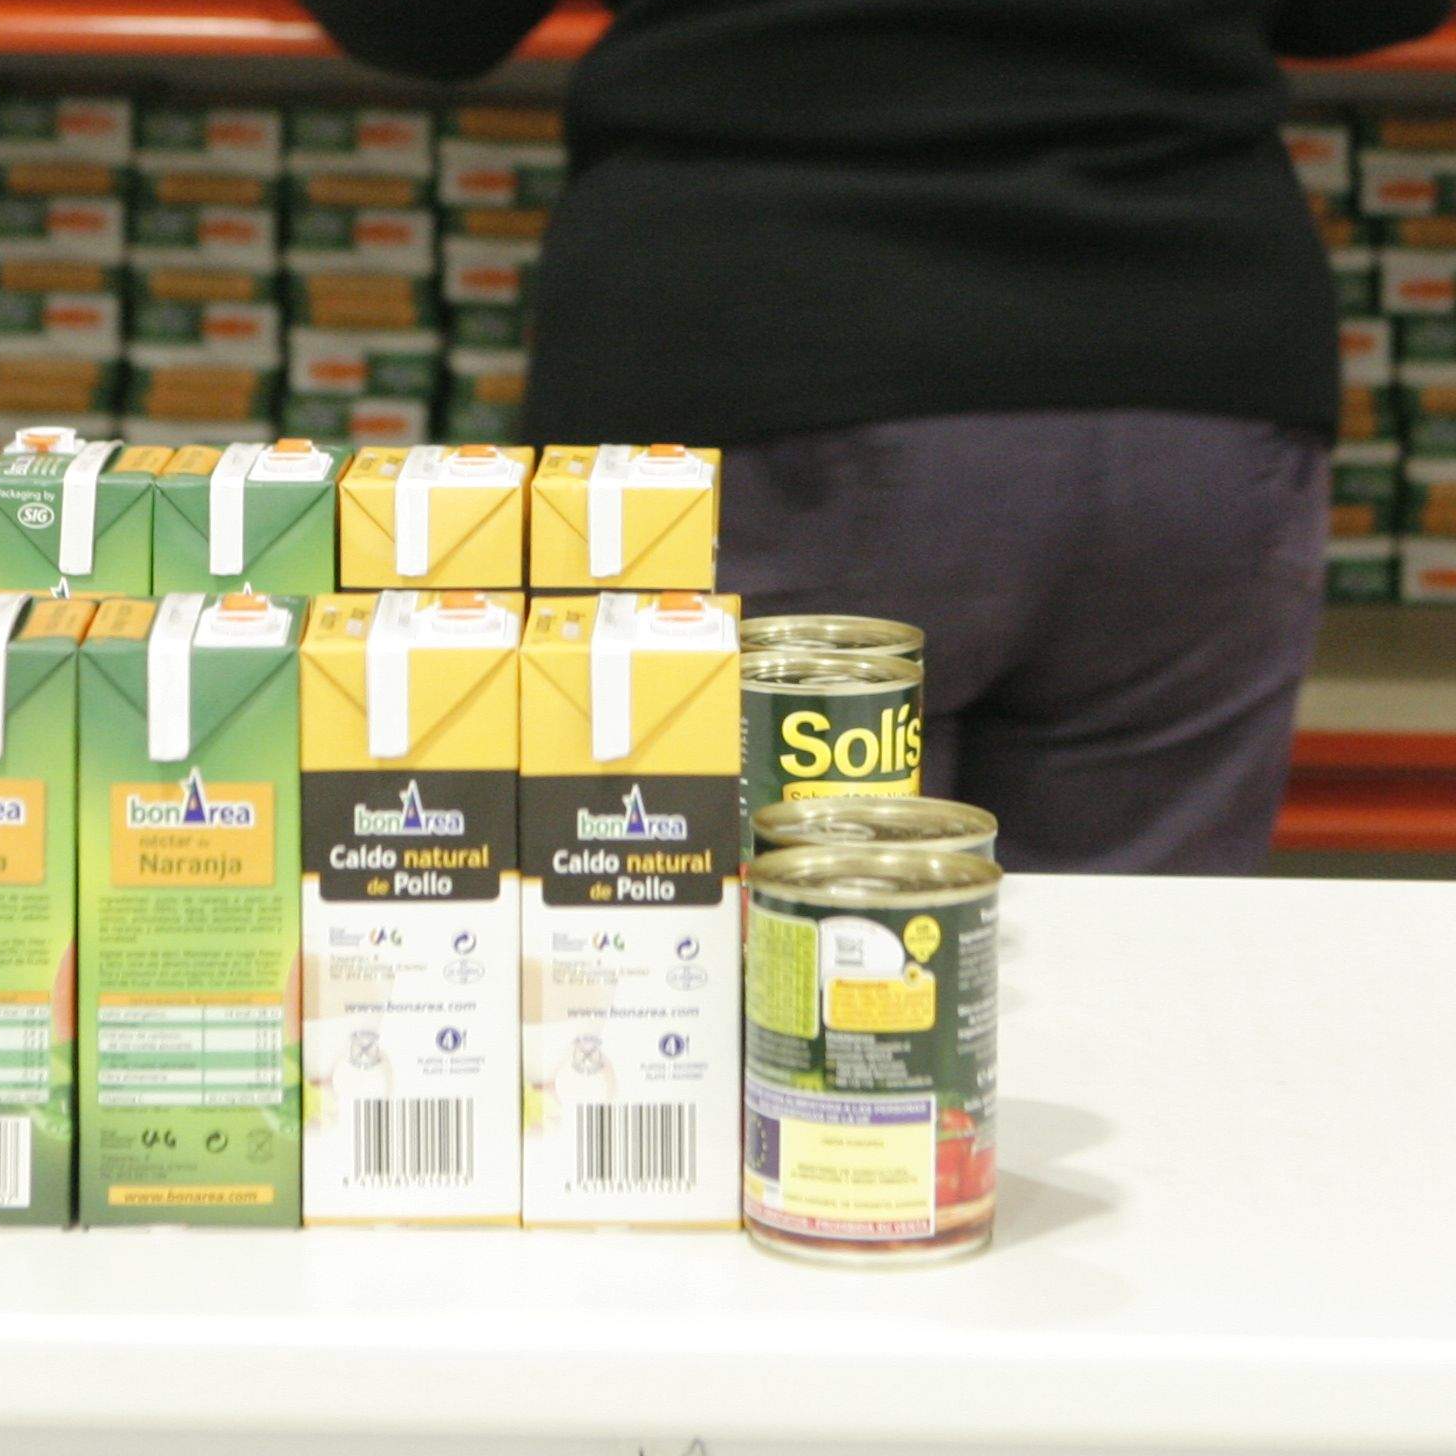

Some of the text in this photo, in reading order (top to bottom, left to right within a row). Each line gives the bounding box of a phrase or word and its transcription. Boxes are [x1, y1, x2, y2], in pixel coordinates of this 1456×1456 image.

[43, 490, 56, 503] by
[23, 508, 49, 523] SIG
[139, 853, 242, 879] Naranja
[330, 844, 489, 869] Caldo natural
[552, 849, 712, 874] Caldo natural
[366, 871, 453, 895] de Pollo
[589, 876, 676, 901] de Pollo
